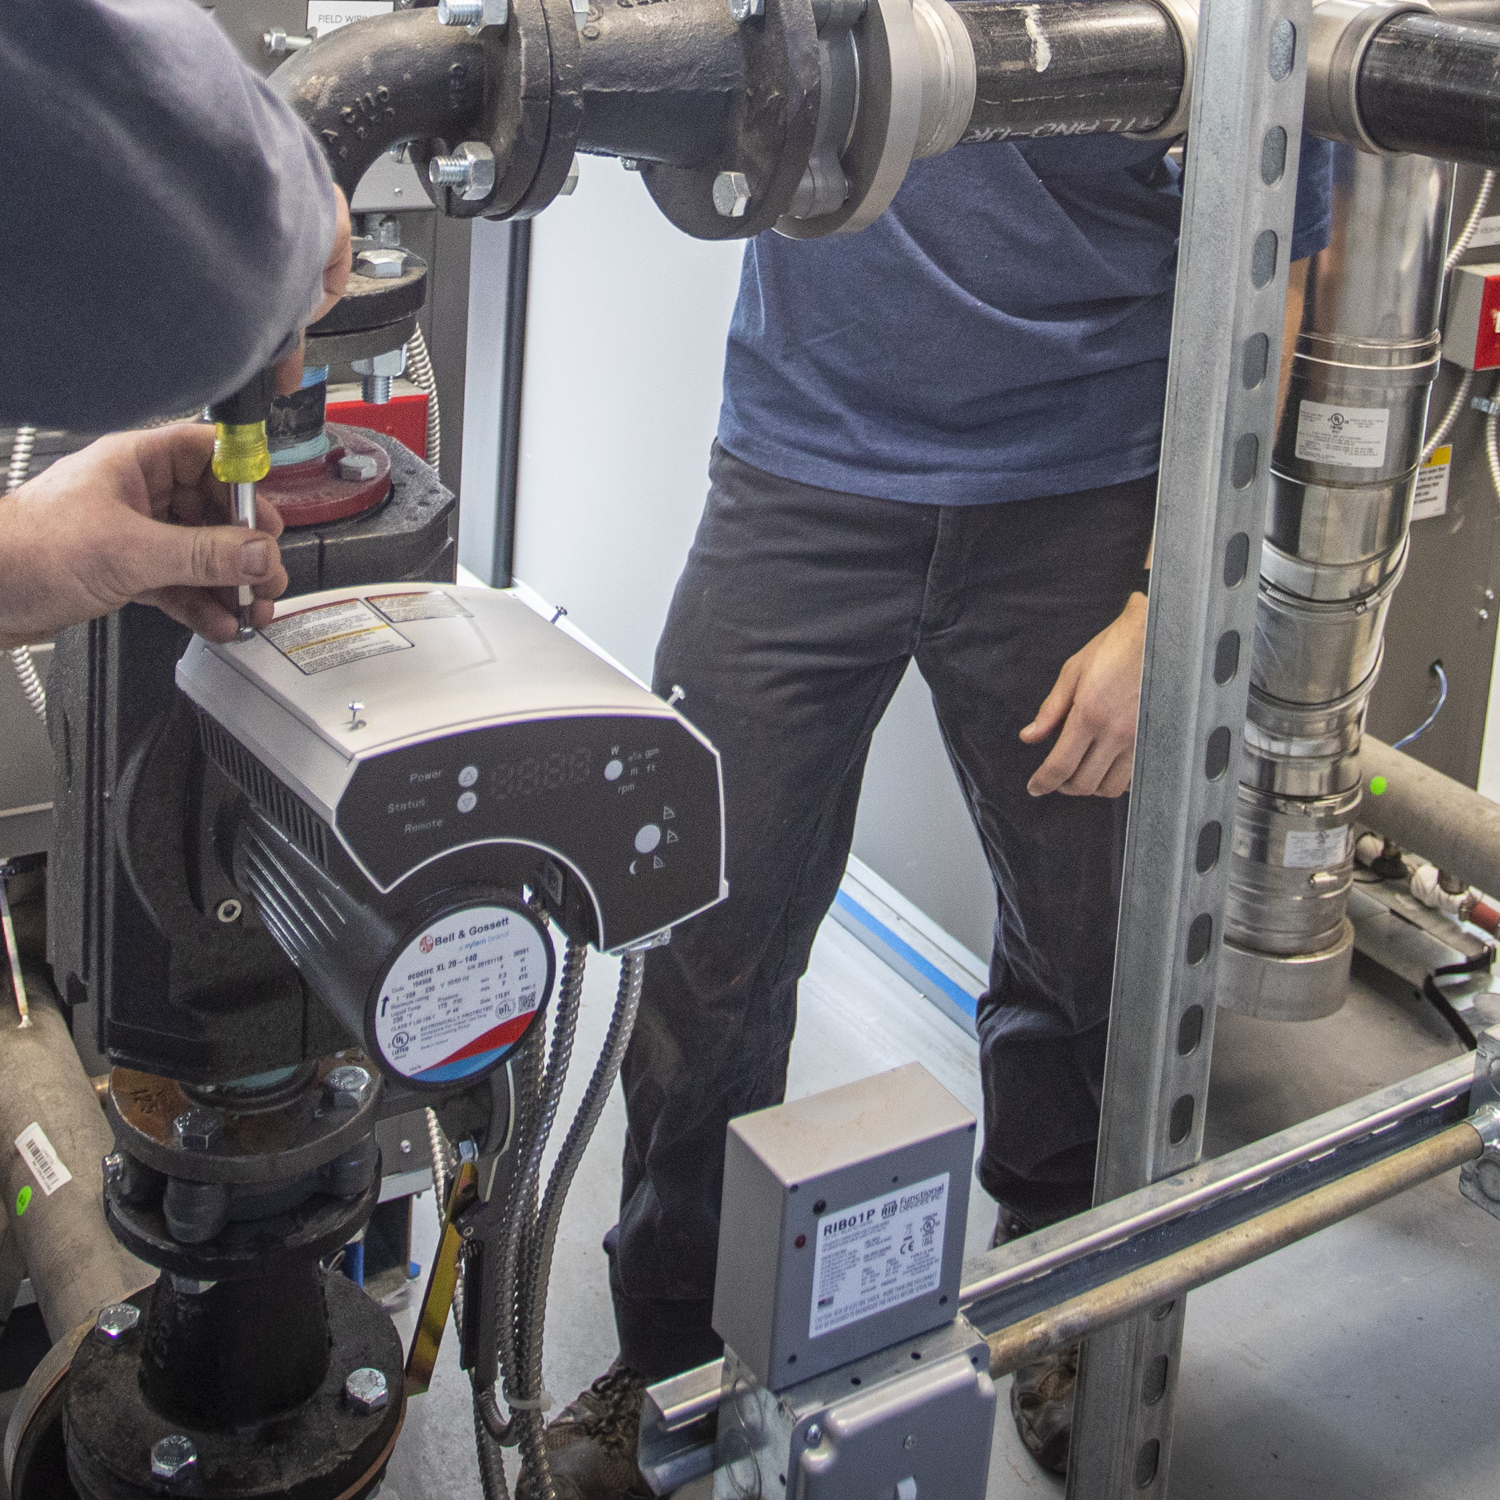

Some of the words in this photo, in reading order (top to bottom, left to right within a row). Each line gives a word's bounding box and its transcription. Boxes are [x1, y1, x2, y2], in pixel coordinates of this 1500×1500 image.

[318, 14, 342, 24] FIELD
[610, 745, 620, 756] W
[409, 769, 443, 783] Power
[617, 784, 635, 795] rpm
[387, 798, 426, 814] Status
[404, 819, 444, 834] Remote
[434, 932, 454, 946] Bell
[458, 928, 466, 939] &
[469, 917, 509, 936] Gossett
[464, 938, 486, 951] xylem
[488, 931, 509, 943] brand
[436, 963, 447, 974] XL
[498, 1003, 512, 1015] BTL
[823, 1208, 876, 1237] RIB01P
[900, 1183, 945, 1205] Functional
[900, 1240, 915, 1255] CE
